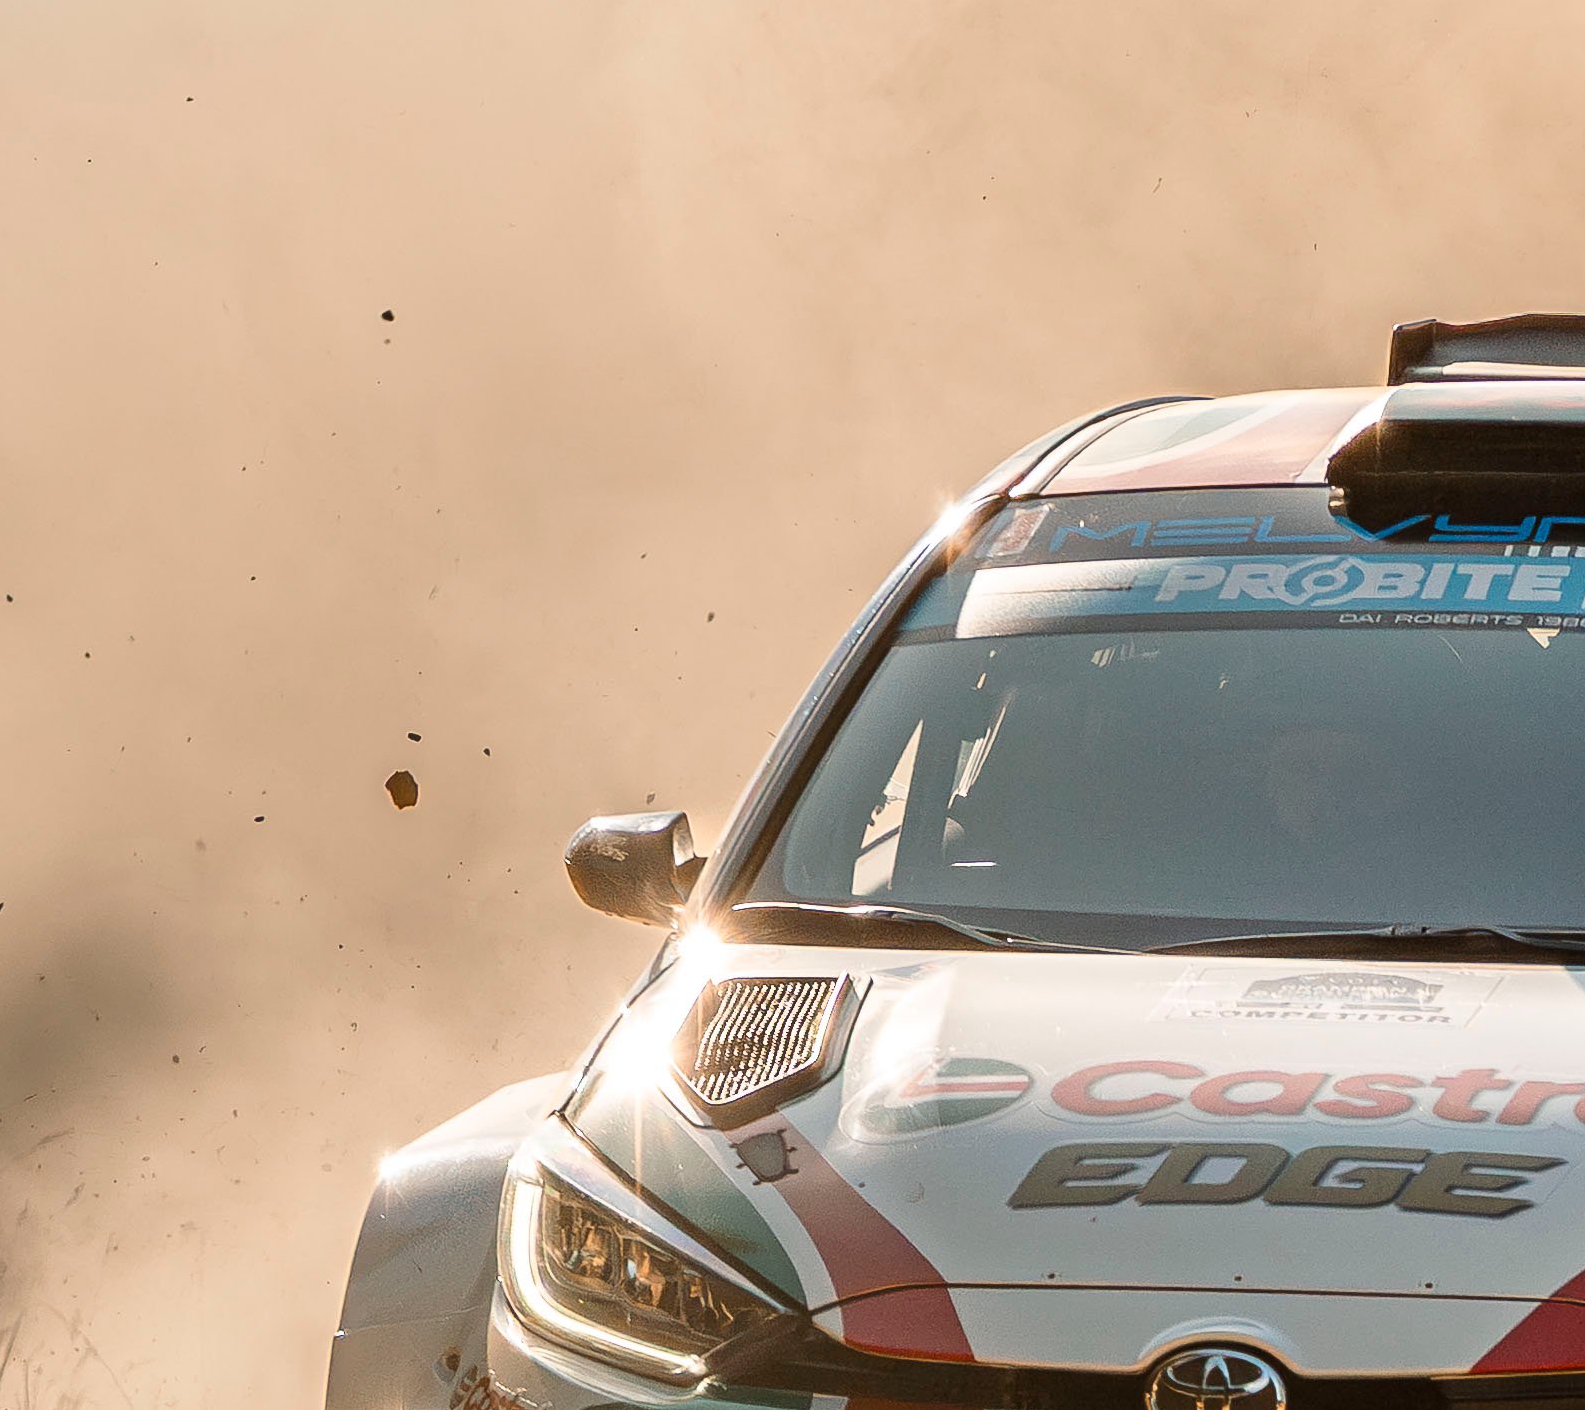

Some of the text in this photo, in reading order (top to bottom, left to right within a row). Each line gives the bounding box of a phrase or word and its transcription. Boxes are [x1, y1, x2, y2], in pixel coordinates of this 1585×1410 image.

[1155, 556, 1570, 605] PROBITE
[1339, 613, 1381, 624] DAI
[1394, 614, 1523, 626] ROBERTS
[1190, 1009, 1452, 1024] COMPETITOR
[1008, 1141, 1570, 1219] EDGE
